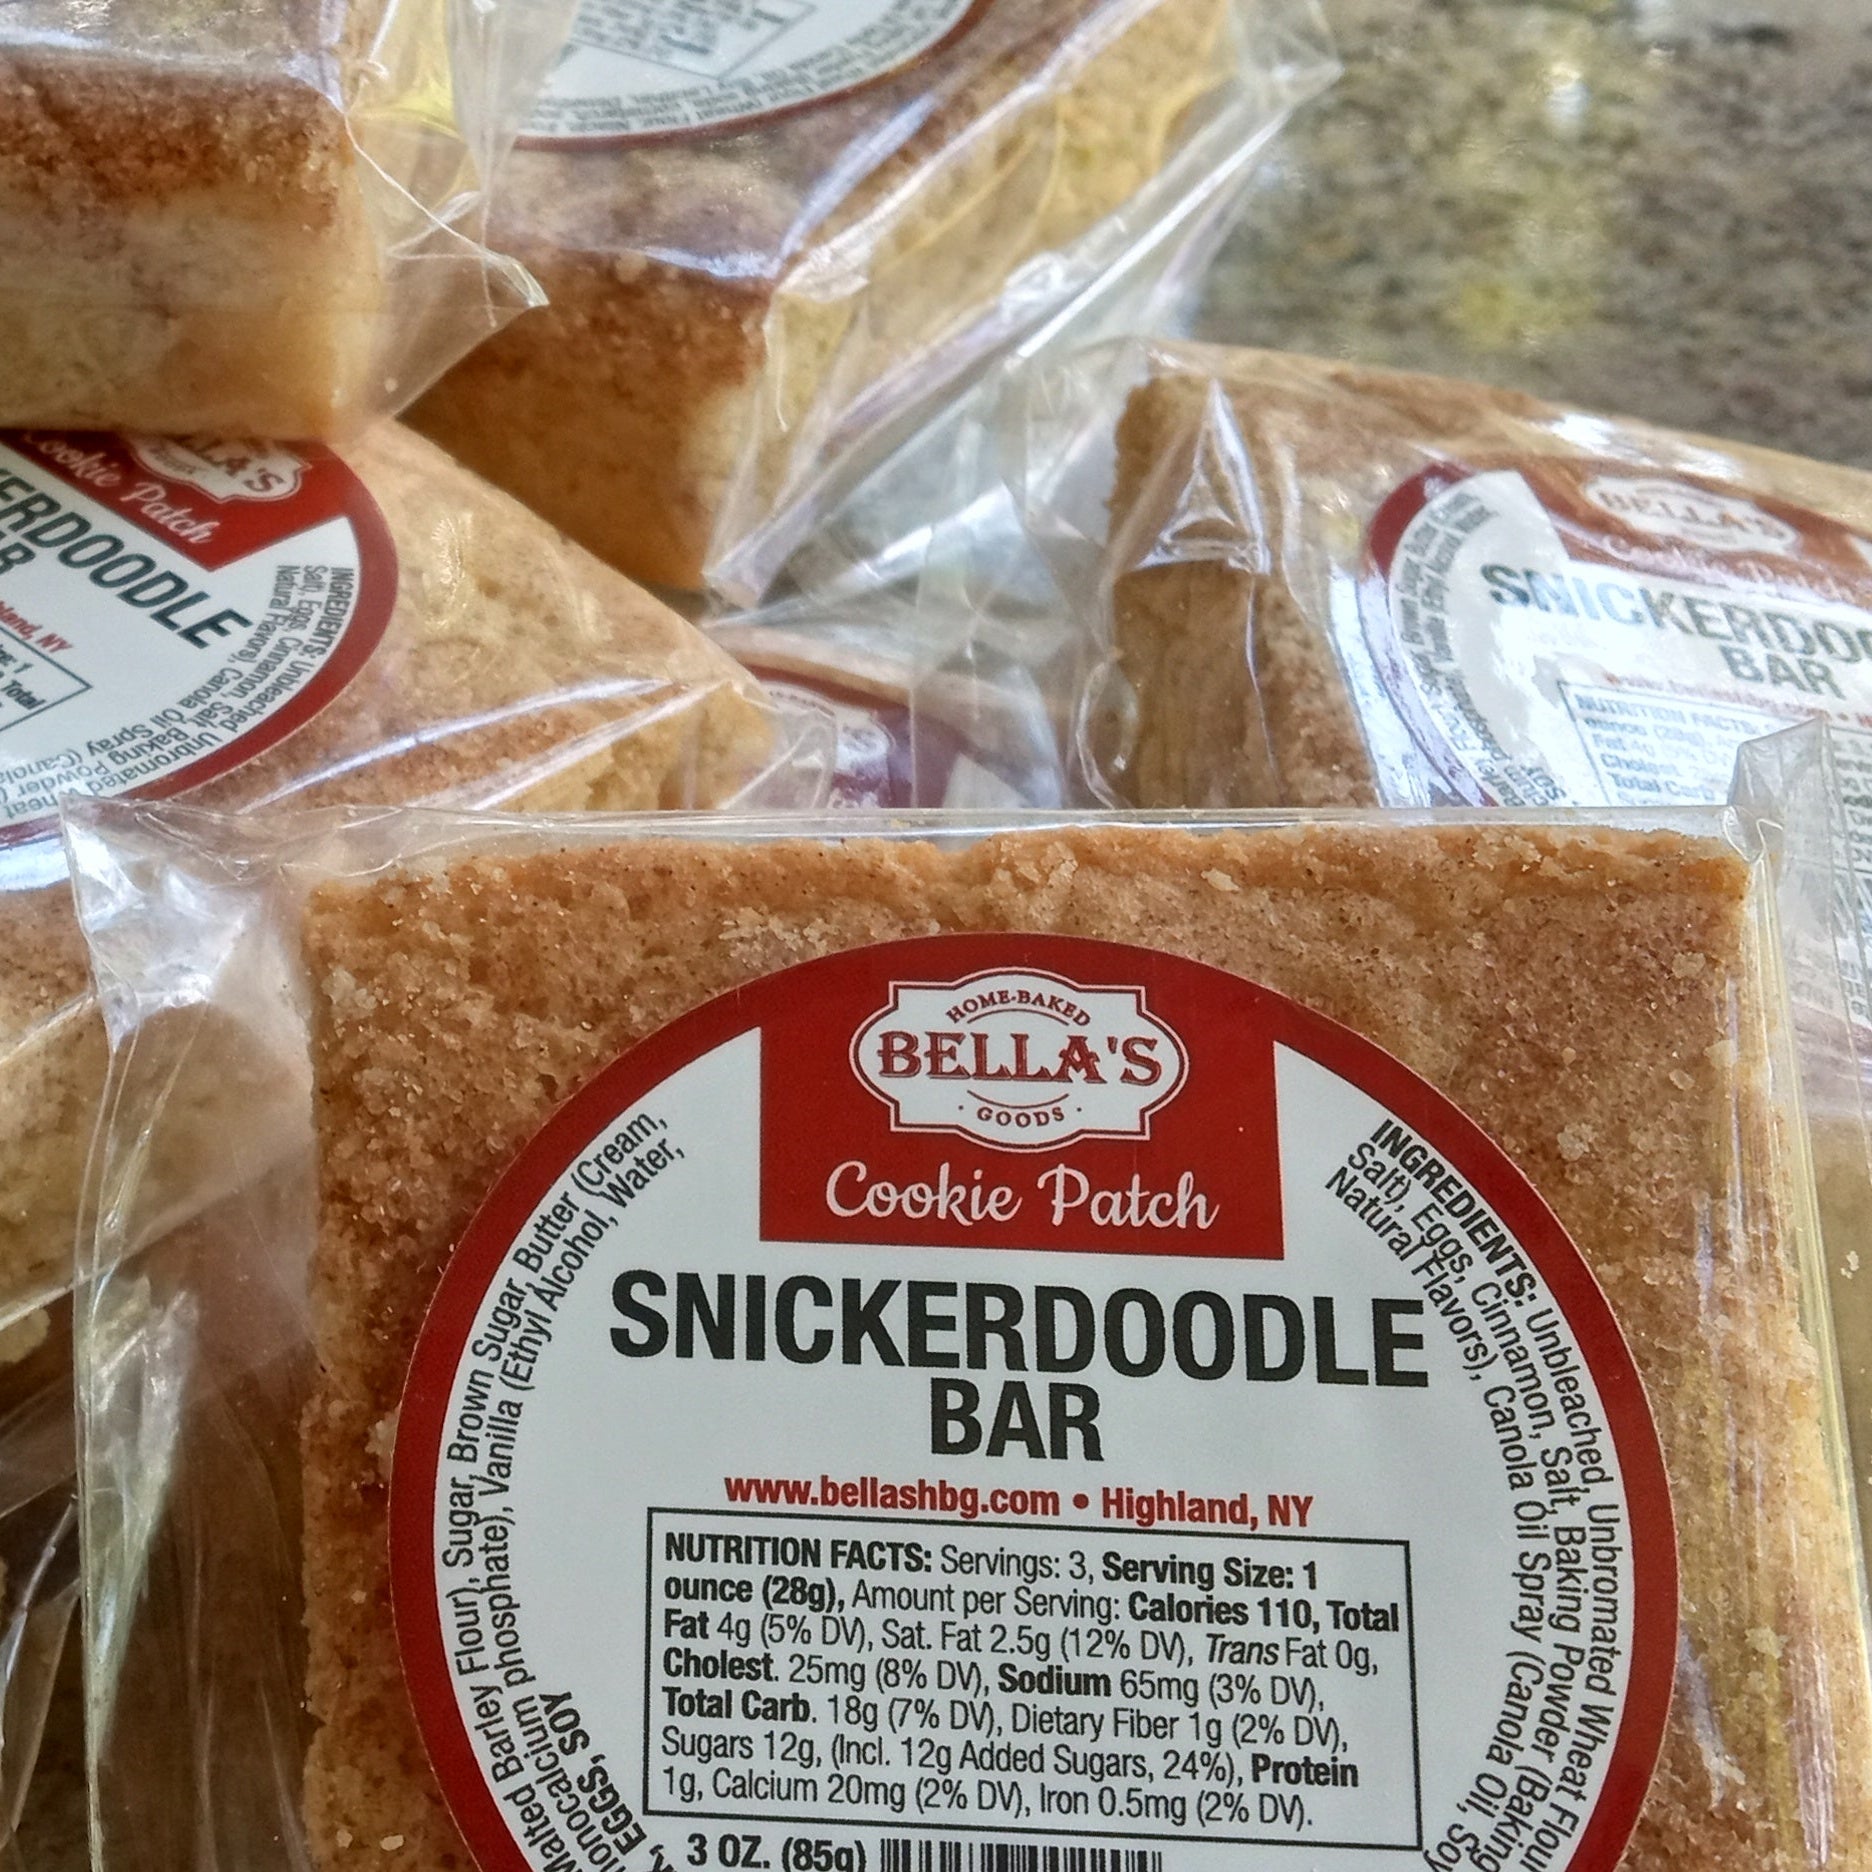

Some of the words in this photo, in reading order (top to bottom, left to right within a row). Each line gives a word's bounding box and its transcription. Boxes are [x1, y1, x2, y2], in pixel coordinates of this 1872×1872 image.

[119, 481, 221, 544] Patch
[0, 467, 252, 650] ERDOODLE
[36, 633, 73, 653] NY
[299, 566, 355, 660] INGREDIENTS:
[176, 667, 243, 709] Canola
[1718, 644, 1847, 700] BAR
[86, 724, 154, 756] Spray
[107, 726, 190, 766] Baking
[945, 990, 1092, 1027] HOME-BAKED
[877, 1030, 1162, 1086] BELLA'S
[571, 1113, 668, 1197] (Cream,
[977, 1106, 1065, 1128] GOODS
[600, 1138, 685, 1208] Water,
[825, 1160, 1023, 1227] Cookie
[1037, 1162, 1220, 1229] Patch
[1325, 1166, 1423, 1262] Natural
[1348, 1142, 1412, 1213] Salt),
[1370, 1118, 1537, 1307] INGREDIENTS:
[512, 1191, 580, 1274] Butter
[534, 1208, 619, 1312] Alcohol,
[1411, 1202, 1474, 1284] Eggs,
[471, 1278, 534, 1362] Sugar,
[499, 1309, 552, 1391] (Ethyl
[609, 1267, 1429, 1390] SNICKERDOODLE
[1411, 1256, 1498, 1380] Flavors),
[1471, 1281, 1556, 1440] Cinnamon,
[1526, 1307, 1614, 1494] Unbleached,
[446, 1369, 494, 1463] Brown
[478, 1400, 523, 1496] Vanilla
[930, 1378, 1105, 1462] BAR
[1483, 1385, 1538, 1491] Canola
[442, 1474, 481, 1567] Sugar,
[724, 1475, 1060, 1519] www.bellashbg.com
[1102, 1487, 1259, 1532] Highland,
[1267, 1494, 1314, 1527] NY
[1514, 1501, 1550, 1539] Oil
[1540, 1446, 1581, 1514] Salt,
[478, 1506, 536, 1688] phosphate),
[665, 1532, 821, 1568] NUTRITION
[830, 1539, 932, 1573] FACTS:
[941, 1544, 1061, 1584] Servings:
[1069, 1550, 1094, 1585] 3,
[1102, 1551, 1214, 1591] Serving
[1223, 1557, 1294, 1589] Size:
[1302, 1561, 1317, 1590] 1
[1510, 1552, 1552, 1643] Spray
[1548, 1526, 1589, 1633] Baking
[1585, 1504, 1623, 1697] Unbromated
[446, 1577, 490, 1676] Flour),
[664, 1576, 753, 1602] ounce
[762, 1574, 845, 1613] (28g),
[852, 1578, 955, 1613] Amount
[963, 1590, 1006, 1619] per
[1014, 1585, 1120, 1626] Serving:
[1128, 1590, 1249, 1626] Calories
[1258, 1597, 1320, 1634] 110,
[1326, 1600, 1399, 1632] Total
[664, 1608, 709, 1641] Fat
[717, 1611, 751, 1648] 4g
[761, 1612, 812, 1648] (5%
[822, 1615, 873, 1653] DV),
[882, 1617, 932, 1651] Sat.
[941, 1620, 982, 1652] Fat
[989, 1624, 1051, 1662] 2.5g
[1061, 1626, 1131, 1663] (12%
[1141, 1629, 1194, 1669] DV),
[1206, 1632, 1280, 1667] Trans
[1285, 1636, 1328, 1669] Fat
[1335, 1639, 1378, 1677] 0g,
[662, 1647, 779, 1683] Cholest.
[788, 1653, 866, 1692] 25mg
[876, 1657, 928, 1694] (8%
[937, 1660, 989, 1698] DV),
[998, 1662, 1112, 1698] Sodium
[1120, 1669, 1199, 1708] 65mg
[1209, 1673, 1262, 1709] (3%
[1271, 1675, 1324, 1713] DV),
[662, 1686, 733, 1719] Total
[741, 1689, 817, 1724] Carb.
[828, 1694, 878, 1733] 18g
[888, 1697, 940, 1733] (7%
[950, 1700, 1002, 1738] DV),
[1012, 1702, 1105, 1743] Dietary
[1113, 1707, 1180, 1741] Fiber
[1189, 1709, 1222, 1749] 1g
[1232, 1712, 1285, 1750] (2%
[1294, 1716, 1348, 1753] DV),
[1485, 1651, 1546, 1765] (Canola
[1531, 1642, 1585, 1763] Powder
[470, 1685, 524, 1784] Barley
[538, 1692, 590, 1756] SOY
[662, 1725, 753, 1764] Sugars
[764, 1730, 822, 1768] 12g,
[832, 1733, 890, 1770] (Incl.
[902, 1737, 951, 1775] 12g
[959, 1739, 1045, 1773] Added
[1053, 1743, 1154, 1782] Sugars,
[1163, 1749, 1243, 1788] 24%),
[1251, 1752, 1359, 1788] Protein
[1555, 1704, 1614, 1802] Wheat
[577, 1753, 647, 1855] EGGS,
[663, 1766, 703, 1803] 1g,
[712, 1767, 818, 1802] Calcium
[827, 1773, 905, 1812] 20mg
[915, 1777, 968, 1814] (2%
[977, 1779, 1030, 1819] DV),
[1040, 1782, 1089, 1815] Iron
[1098, 1786, 1186, 1826] 0.5mg
[1197, 1790, 1249, 1827] (2%
[1258, 1792, 1312, 1831] DV).
[1456, 1772, 1508, 1818] Oil,
[1464, 1765, 1553, 1872] (Baking
[687, 1832, 708, 1867] 3
[718, 1833, 770, 1869] OZ.
[781, 1836, 867, 1872] (85g)
[1423, 1823, 1480, 1872] Soy
